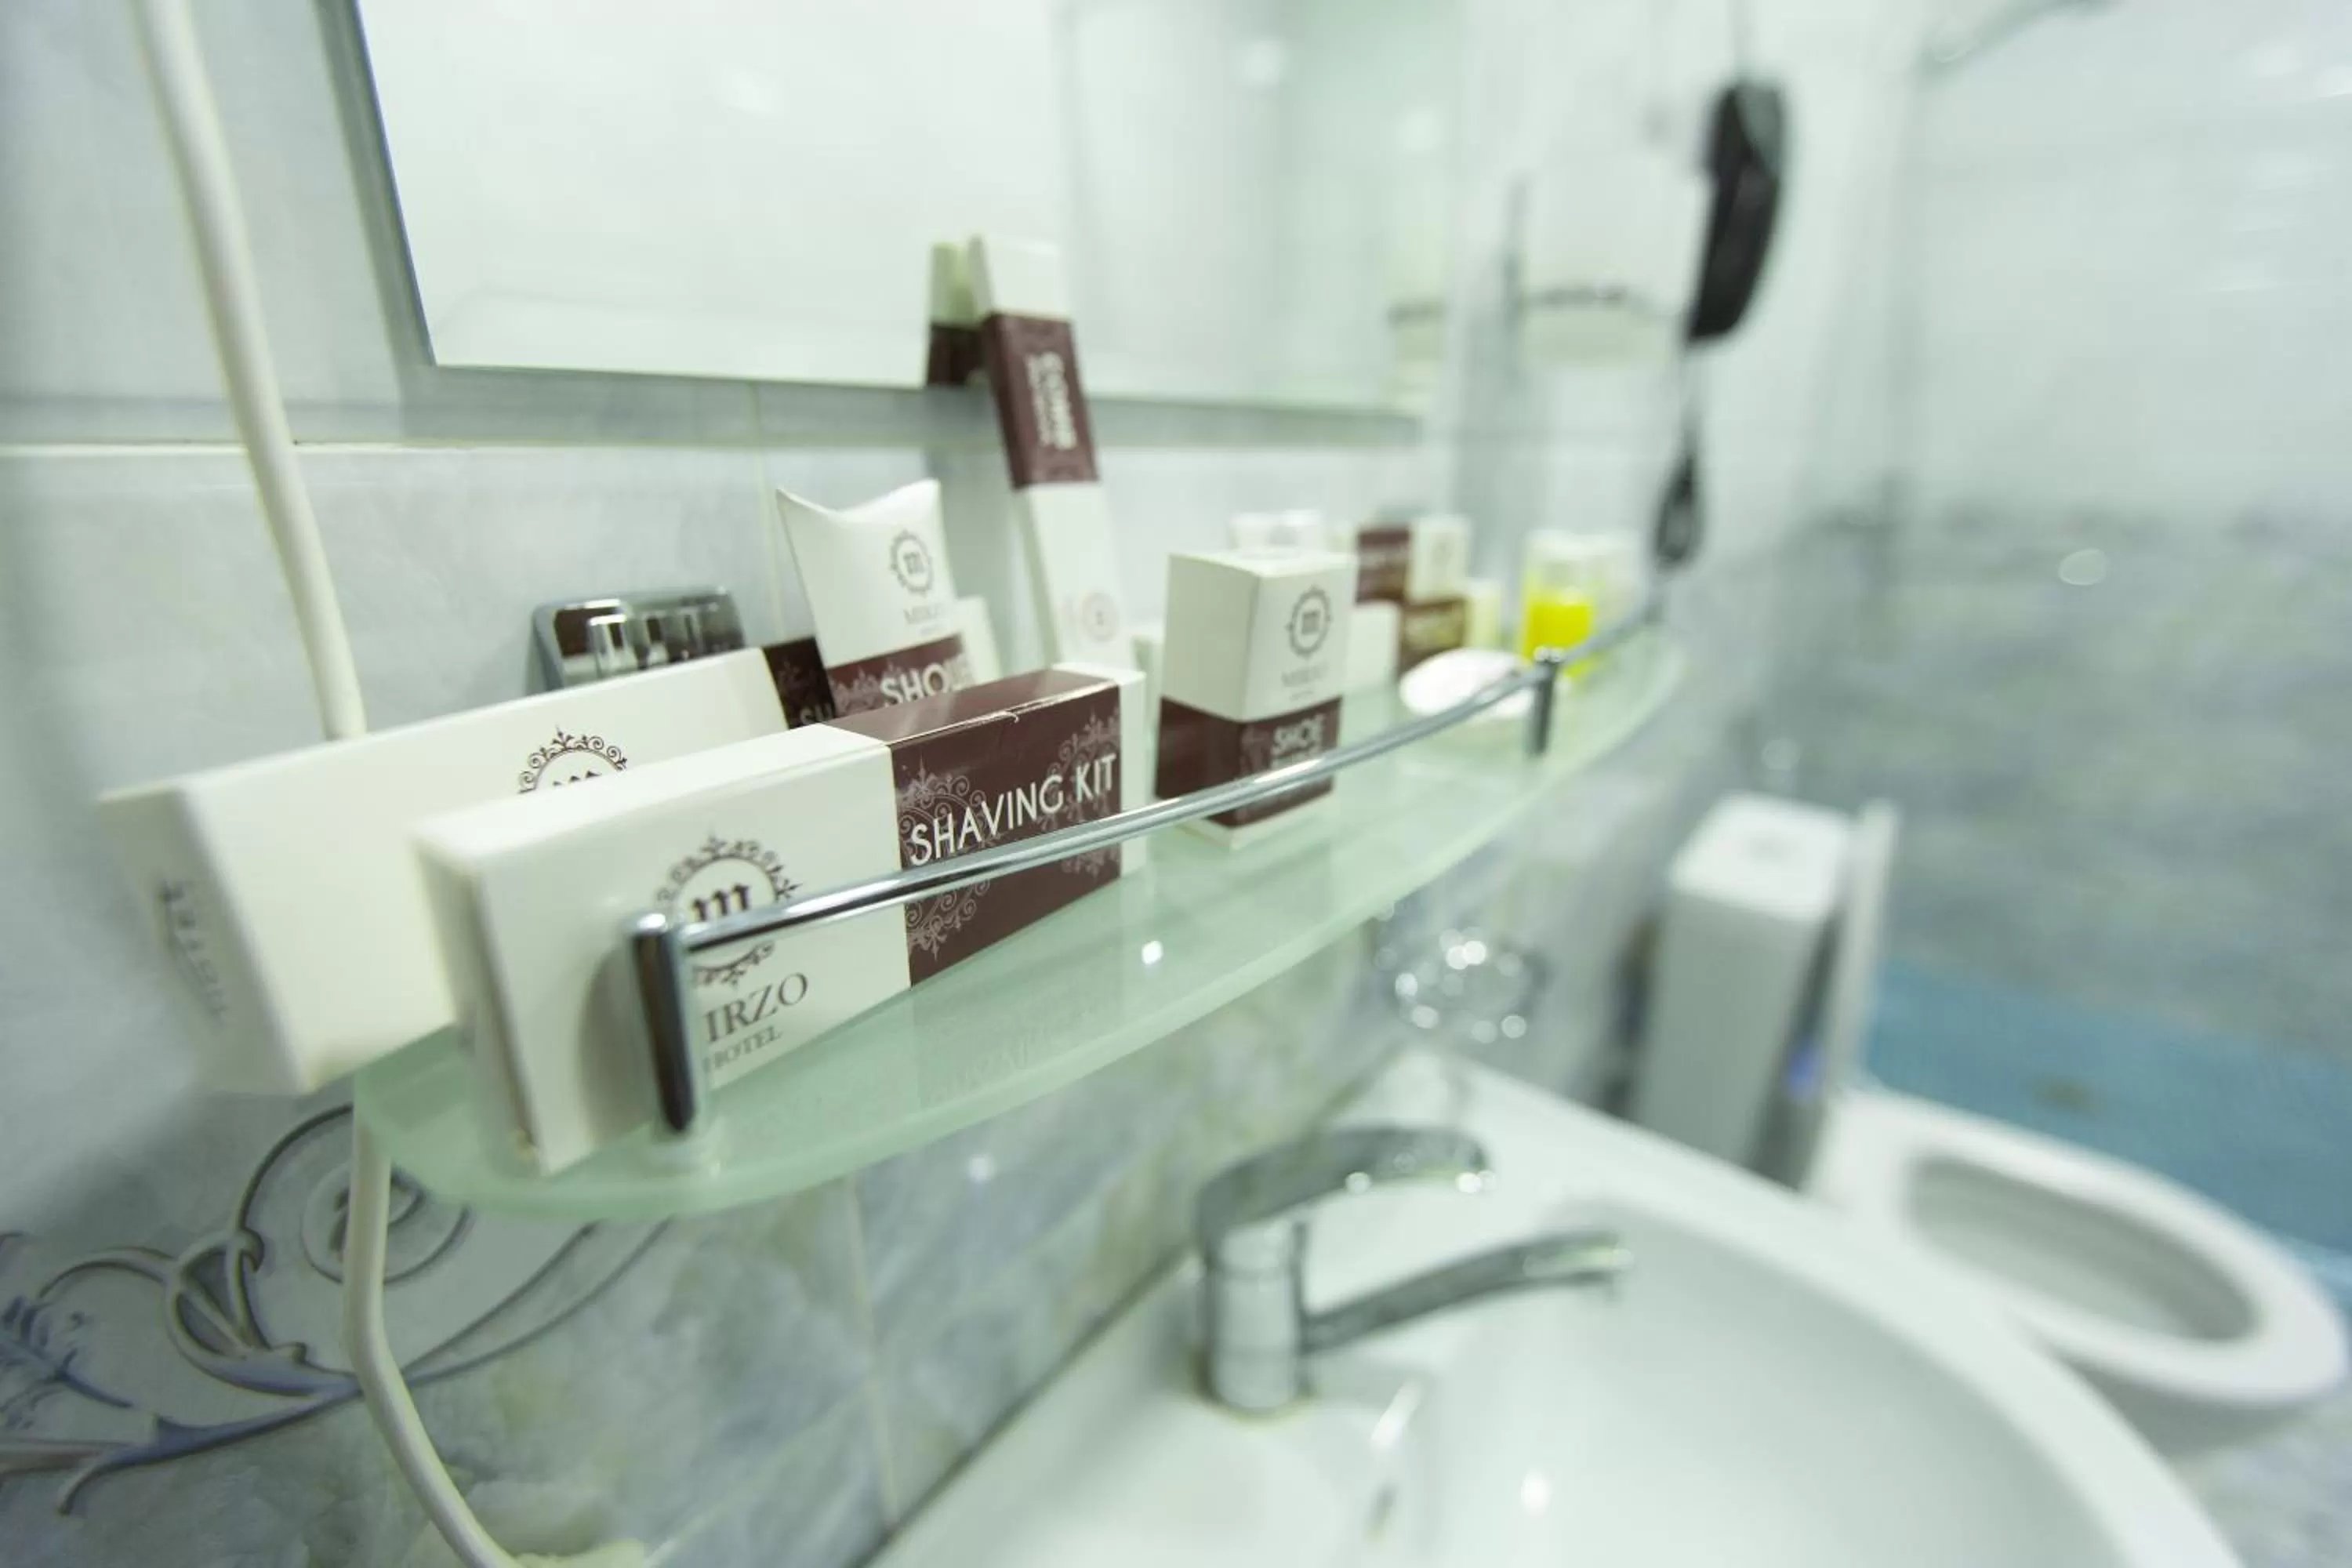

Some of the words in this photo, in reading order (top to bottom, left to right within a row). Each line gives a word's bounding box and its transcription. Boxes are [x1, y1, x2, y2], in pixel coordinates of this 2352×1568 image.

[910, 775, 1063, 866] SHAVING
[1075, 753, 1116, 804] KIT
[703, 972, 808, 1043] IRZO
